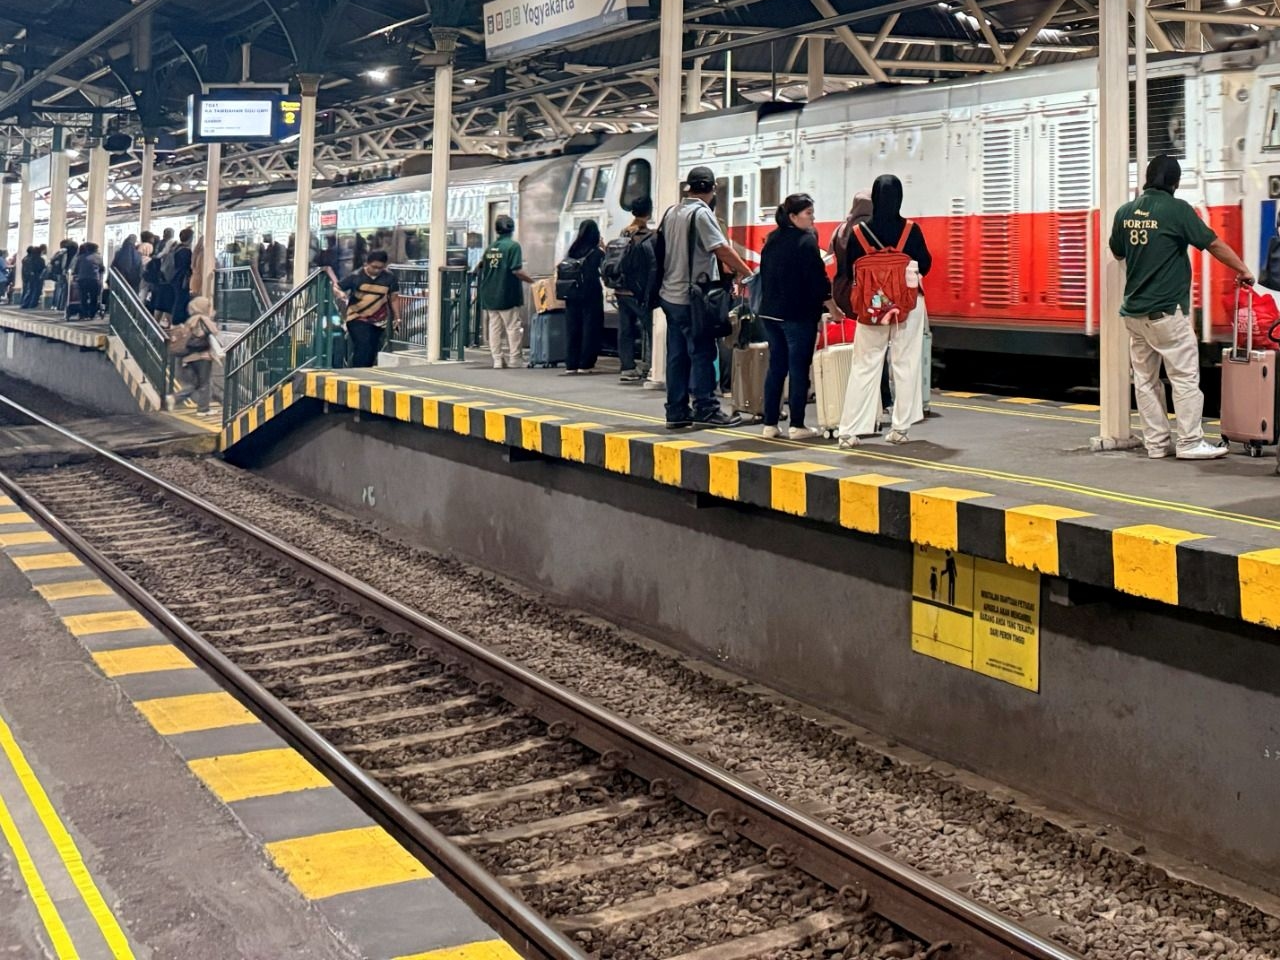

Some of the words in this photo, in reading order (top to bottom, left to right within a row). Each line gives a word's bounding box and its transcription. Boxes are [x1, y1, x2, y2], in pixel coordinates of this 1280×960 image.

[285, 111, 296, 124] 2
[1123, 219, 1158, 229] PORTER
[1130, 229, 1149, 245] 83
